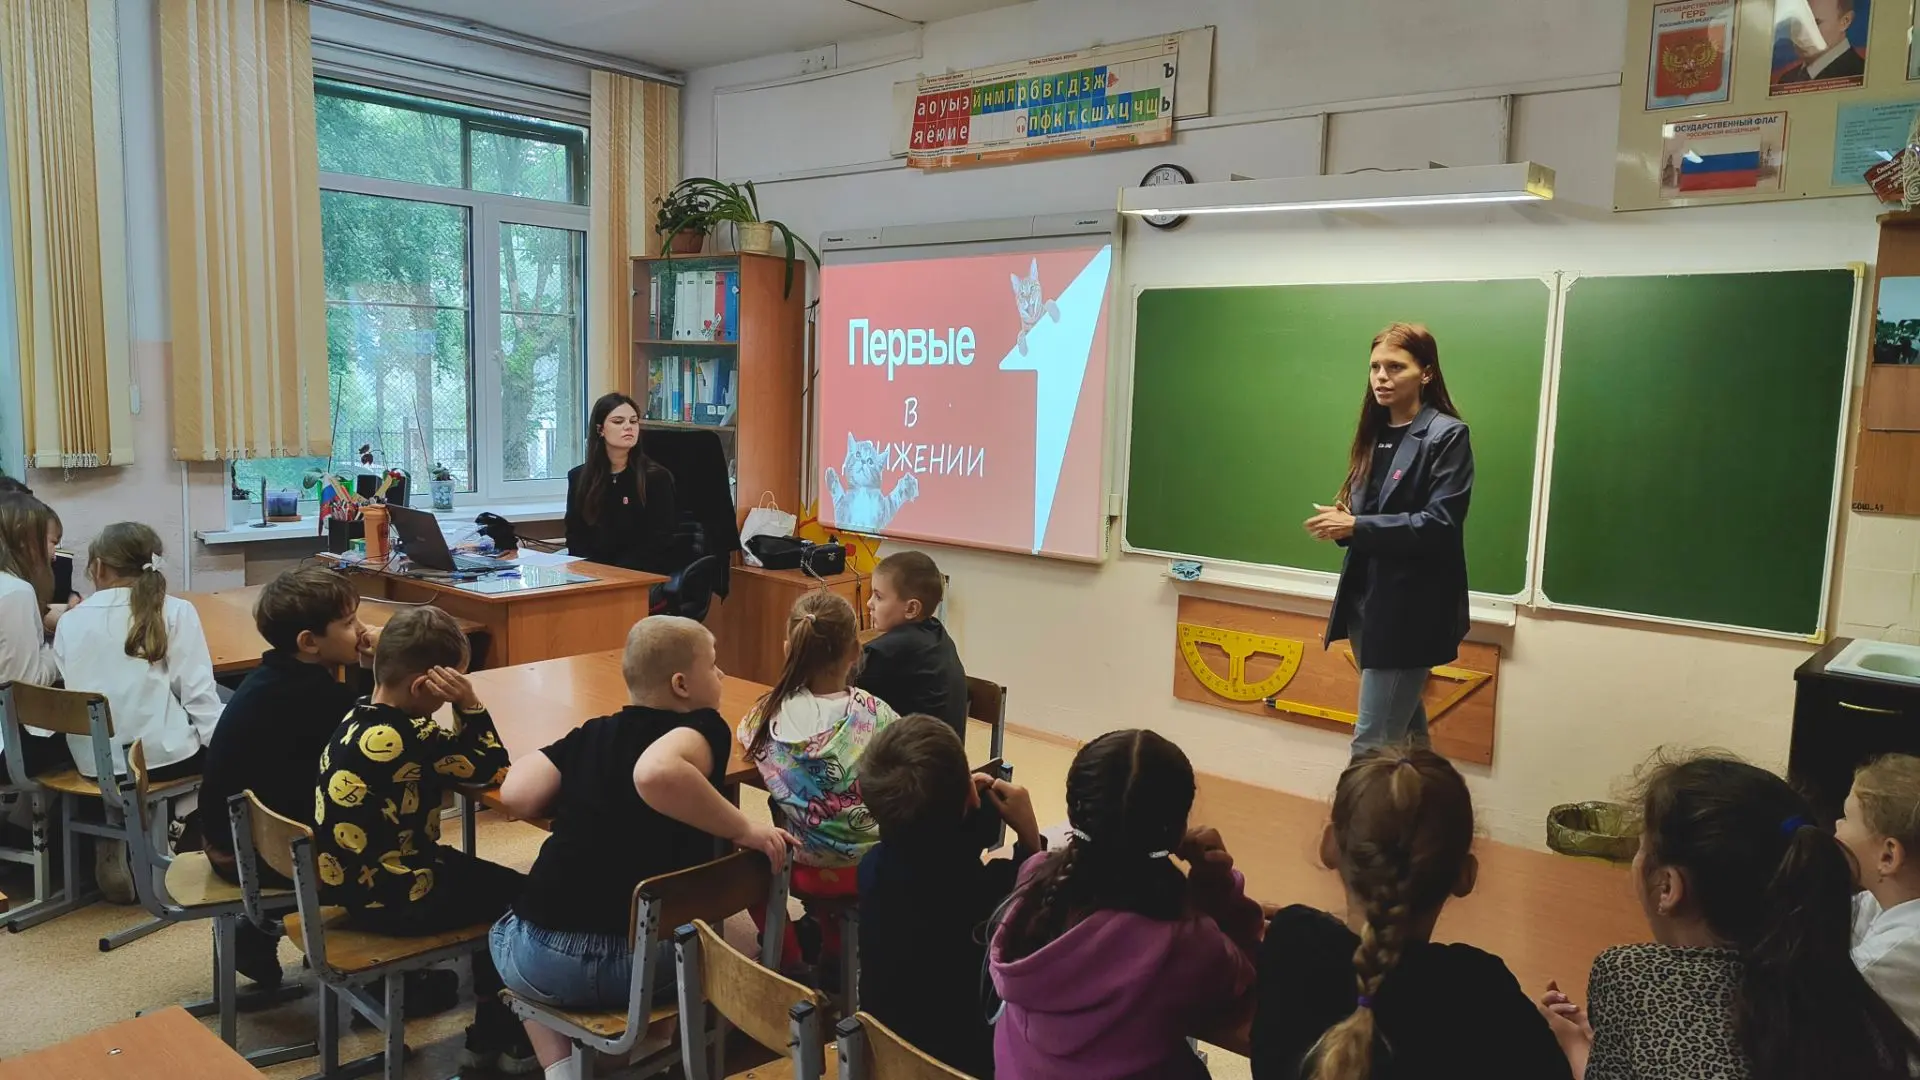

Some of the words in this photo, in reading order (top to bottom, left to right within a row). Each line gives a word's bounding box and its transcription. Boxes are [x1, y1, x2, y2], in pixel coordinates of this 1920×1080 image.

[1681, 9, 1706, 19] ГЕРБ
[1670, 118, 1753, 133] ОСУДАРСТВЕННЫЙ
[1754, 116, 1778, 126] ФЛАГ
[849, 318, 976, 381] Первые
[842, 440, 985, 478] ИЖЕНИИ
